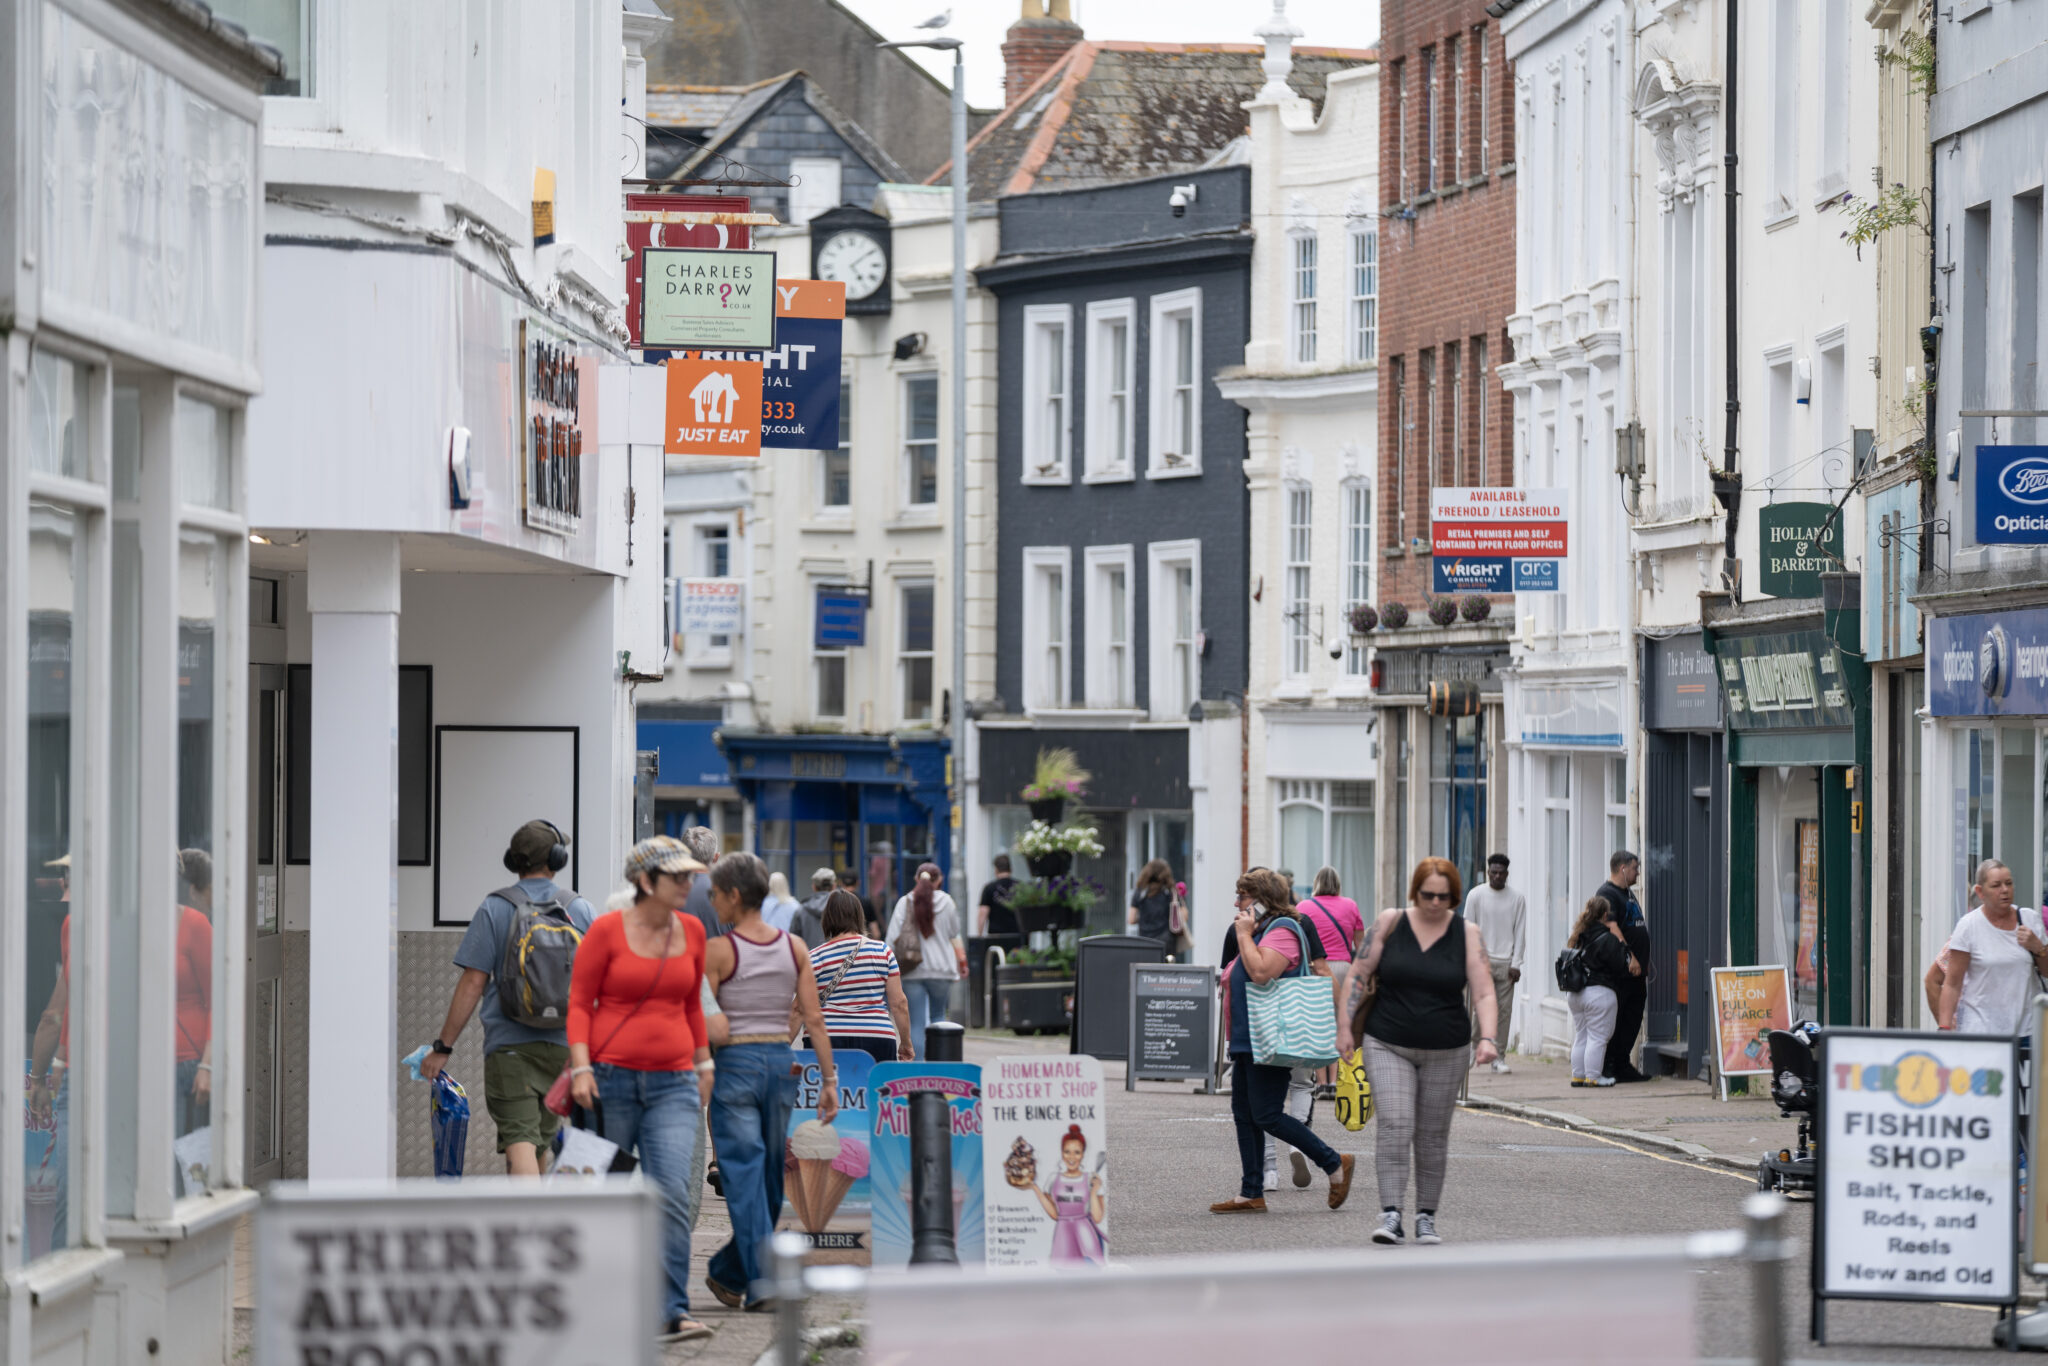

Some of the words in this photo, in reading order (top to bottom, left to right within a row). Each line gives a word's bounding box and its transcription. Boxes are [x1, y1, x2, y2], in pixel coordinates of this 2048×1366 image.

[666, 264, 753, 279] CHARLES
[677, 428, 716, 443] JUST
[718, 429, 749, 444] EAT
[1438, 506, 1490, 517] FREEHOLD
[1500, 506, 1560, 517] LEASEHOLD
[1447, 529, 1472, 538] RETAIL
[1474, 529, 1512, 538] PREMISES
[1514, 529, 1529, 538] AND
[1531, 529, 1550, 538] SELF
[1770, 527, 1834, 543] HOLLAND
[1435, 540, 1476, 549] CONTAINED
[1477, 540, 1503, 549] UPPER
[1504, 540, 1529, 549] FLOOR
[1530, 540, 1564, 549] OFFICES
[1795, 541, 1809, 557] &
[1441, 560, 1503, 577] WRIGHT
[1520, 562, 1551, 576] arc
[1770, 558, 1832, 574] BARRETT
[686, 583, 739, 595] TESCO
[1667, 651, 1678, 676] The
[1679, 651, 1695, 675] Brew
[1695, 650, 1714, 675] House
[1943, 641, 1974, 689] opticians
[1803, 829, 1818, 846] LIVE
[1802, 847, 1816, 864] LIFE
[1142, 975, 1157, 983] The
[1159, 975, 1178, 984] Brew
[1179, 976, 1203, 984] House
[1720, 979, 1745, 991] LIVE
[1721, 990, 1744, 1001] LIFE
[1745, 989, 1766, 1000] ON
[1722, 1000, 1748, 1010] FULL
[1723, 1009, 1773, 1020] CHARGE
[1001, 1061, 1083, 1079] HOMEMADE
[896, 1078, 966, 1094] DELICIOUS
[987, 1082, 1052, 1099] DESSERT
[1061, 1081, 1098, 1098] SHOP
[992, 1105, 1019, 1121] THE
[1025, 1104, 1062, 1121] BINGE
[1068, 1103, 1096, 1120] BOX
[1844, 1111, 1991, 1140] FISHING
[1868, 1144, 1966, 1170] SHOP
[1847, 1182, 1900, 1201] Bait,
[1908, 1183, 1993, 1205] Tackle,
[1863, 1209, 1926, 1230] Rods,
[1935, 1213, 1977, 1229] and
[293, 1223, 584, 1274] THERE'S
[818, 1234, 854, 1247] HERE
[1888, 1237, 1952, 1254] Reels
[1845, 1264, 1897, 1280] New
[1905, 1267, 1946, 1283] and
[1955, 1267, 1993, 1284] Old
[295, 1281, 571, 1332] ALWAYS
